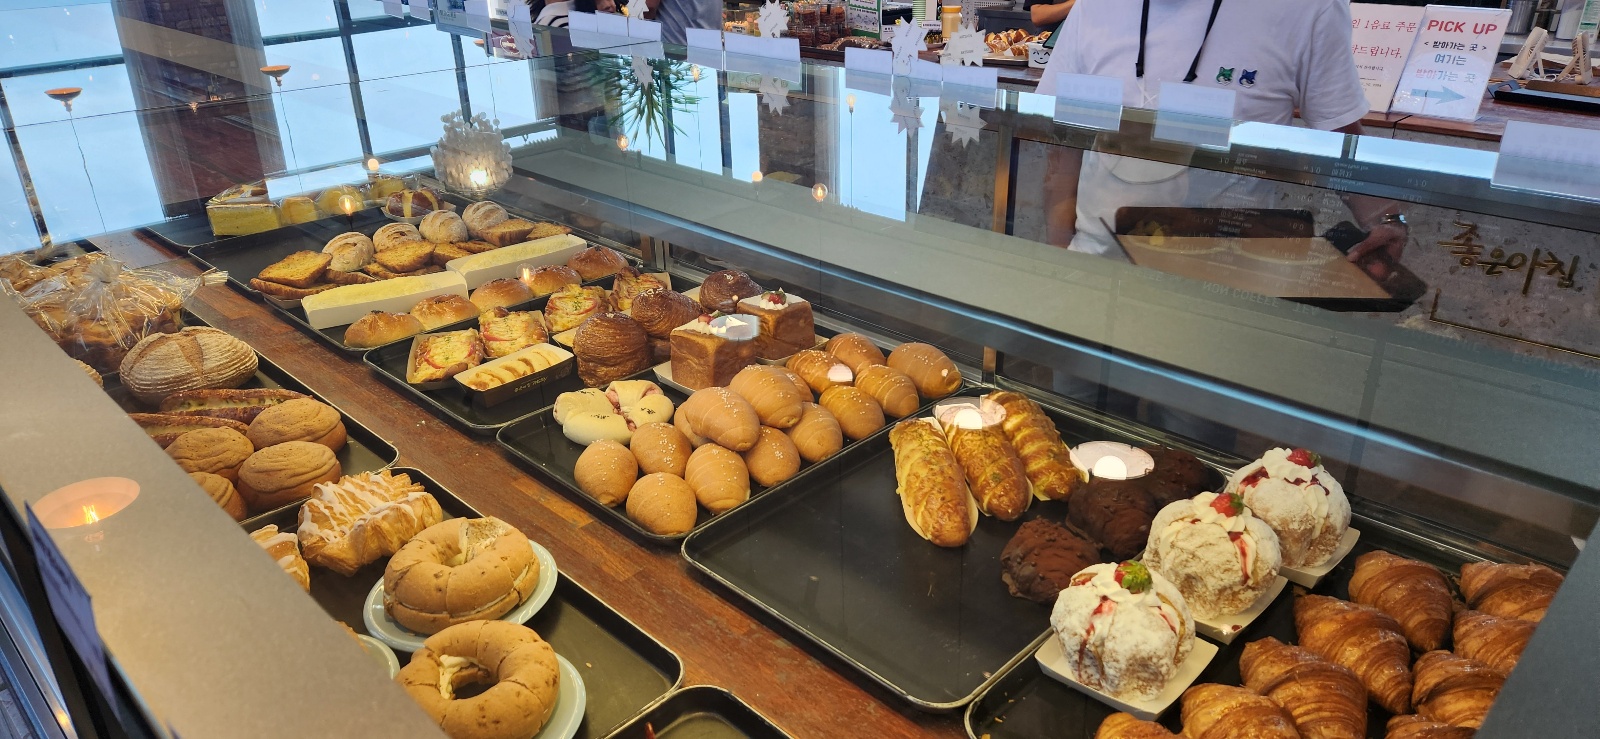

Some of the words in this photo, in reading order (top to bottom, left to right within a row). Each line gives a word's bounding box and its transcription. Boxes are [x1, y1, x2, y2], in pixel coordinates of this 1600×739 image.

[1364, 20, 1391, 30] 1음료
[1395, 21, 1417, 33] 주문
[1427, 19, 1466, 33] PICK
[1472, 22, 1498, 35] UP
[1432, 40, 1465, 51] 받아가는
[1469, 43, 1478, 52] 곳
[1434, 53, 1467, 66] 여기는
[1415, 68, 1459, 82] 받아가는
[1464, 72, 1476, 84] 곳
[1437, 217, 1580, 297] 좋은아침
